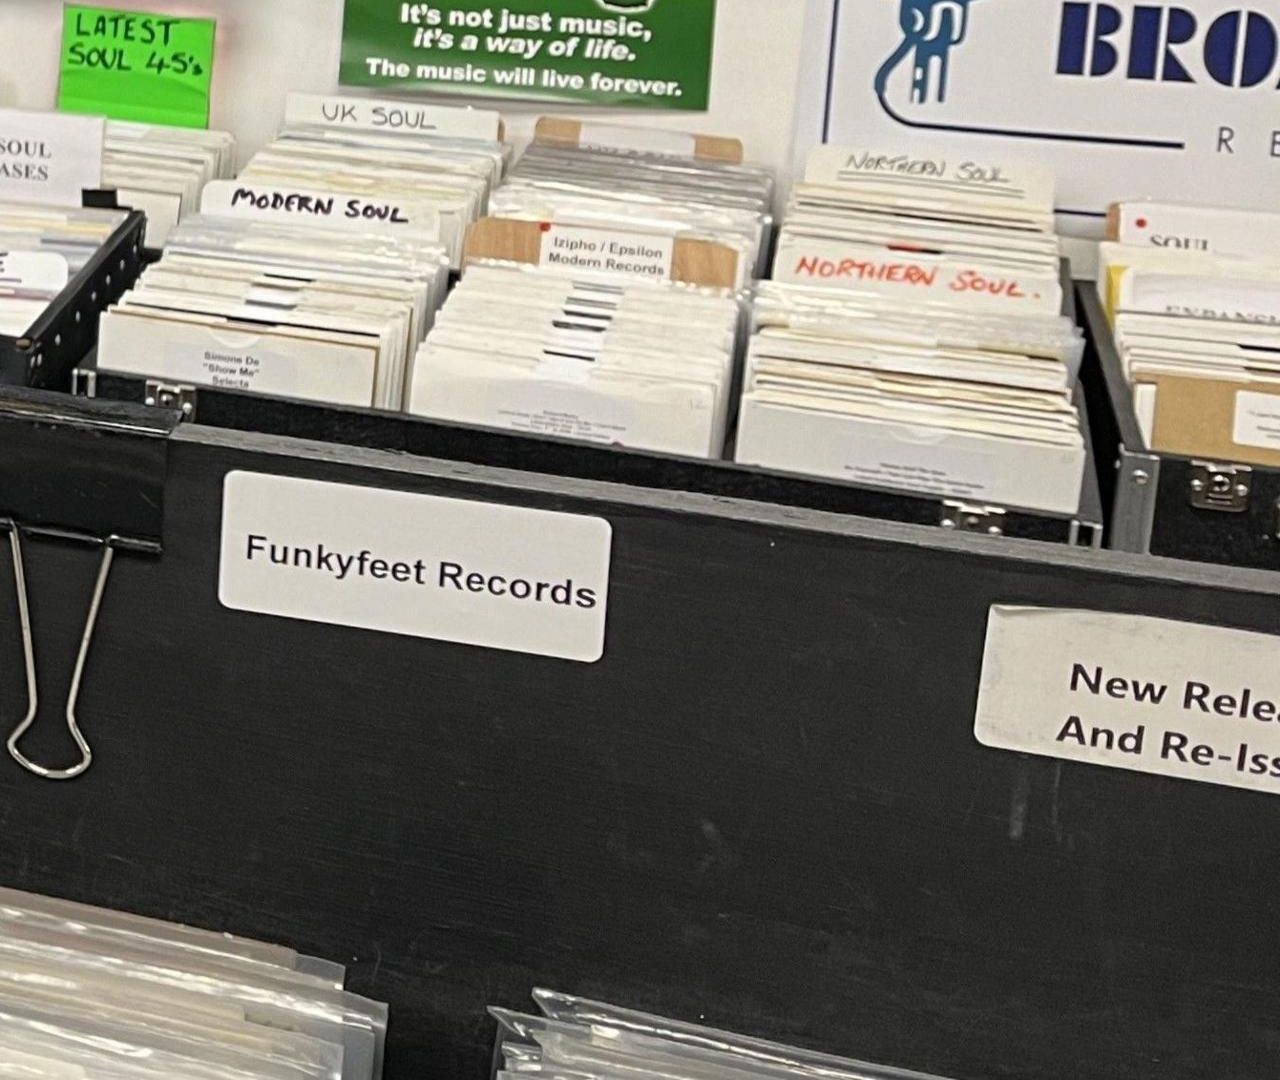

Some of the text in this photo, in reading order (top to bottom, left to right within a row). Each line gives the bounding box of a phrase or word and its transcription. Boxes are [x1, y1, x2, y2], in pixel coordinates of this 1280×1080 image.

[75, 12, 181, 47] LATEST
[400, 3, 652, 42] It's not just music,
[67, 42, 203, 76] SOUL 45's
[413, 28, 637, 62] it's a way of life.
[1056, 1, 1280, 88] BRO
[366, 57, 684, 97] The music will live forever.
[323, 103, 437, 131] UK SOUL
[845, 153, 1011, 185] NORTHERN SOUL
[231, 187, 408, 223] MODERN SOUL
[548, 252, 665, 275] Modern Records
[554, 237, 663, 259] Izipho / Epsilon
[796, 256, 937, 288] NORTHERN
[246, 534, 597, 609] Funkyfeet Records
[1069, 663, 1280, 722] New Rele
[1055, 715, 1145, 755] And
